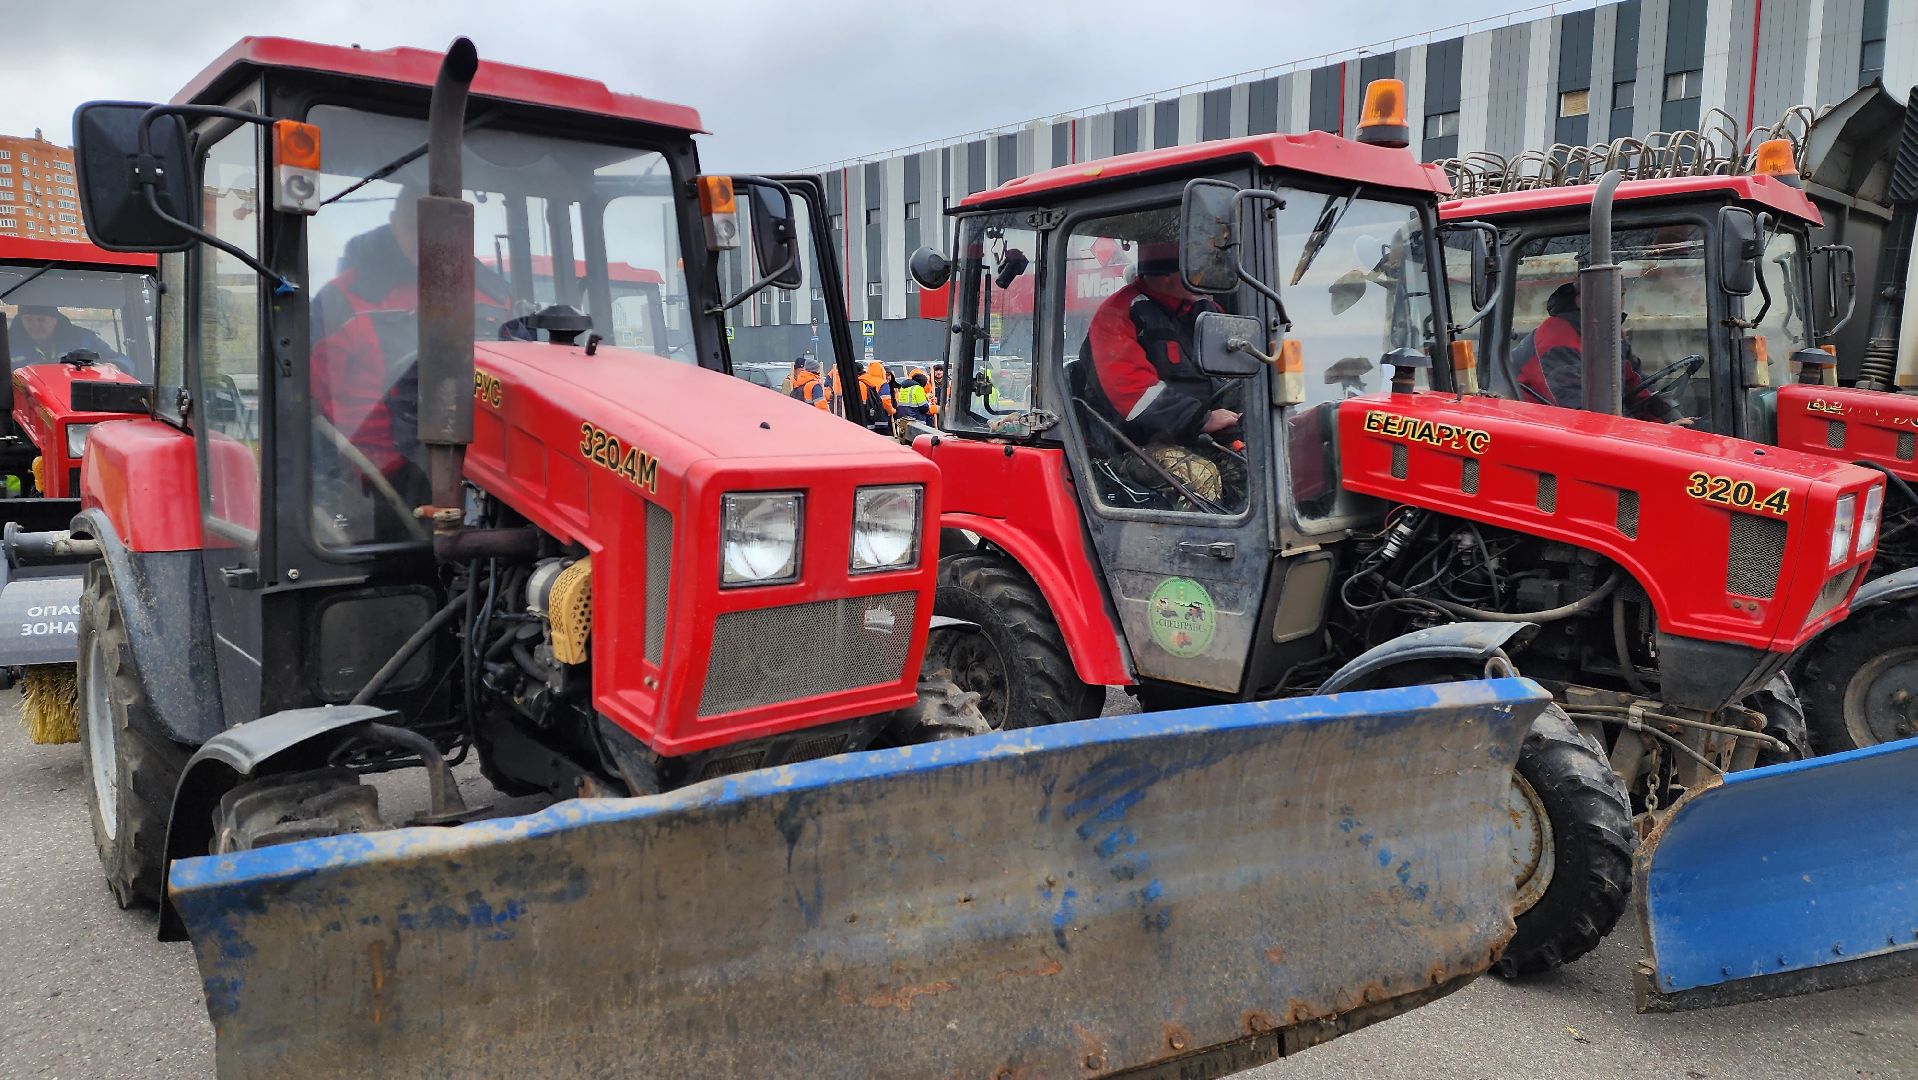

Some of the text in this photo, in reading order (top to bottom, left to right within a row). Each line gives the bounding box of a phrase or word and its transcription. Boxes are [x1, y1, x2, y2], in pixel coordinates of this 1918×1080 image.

[1363, 410, 1491, 455] БЕЛАРУС
[580, 421, 660, 495] 320.4М
[1686, 471, 1791, 516] 320.4
[20, 621, 79, 636] ЗОНА
